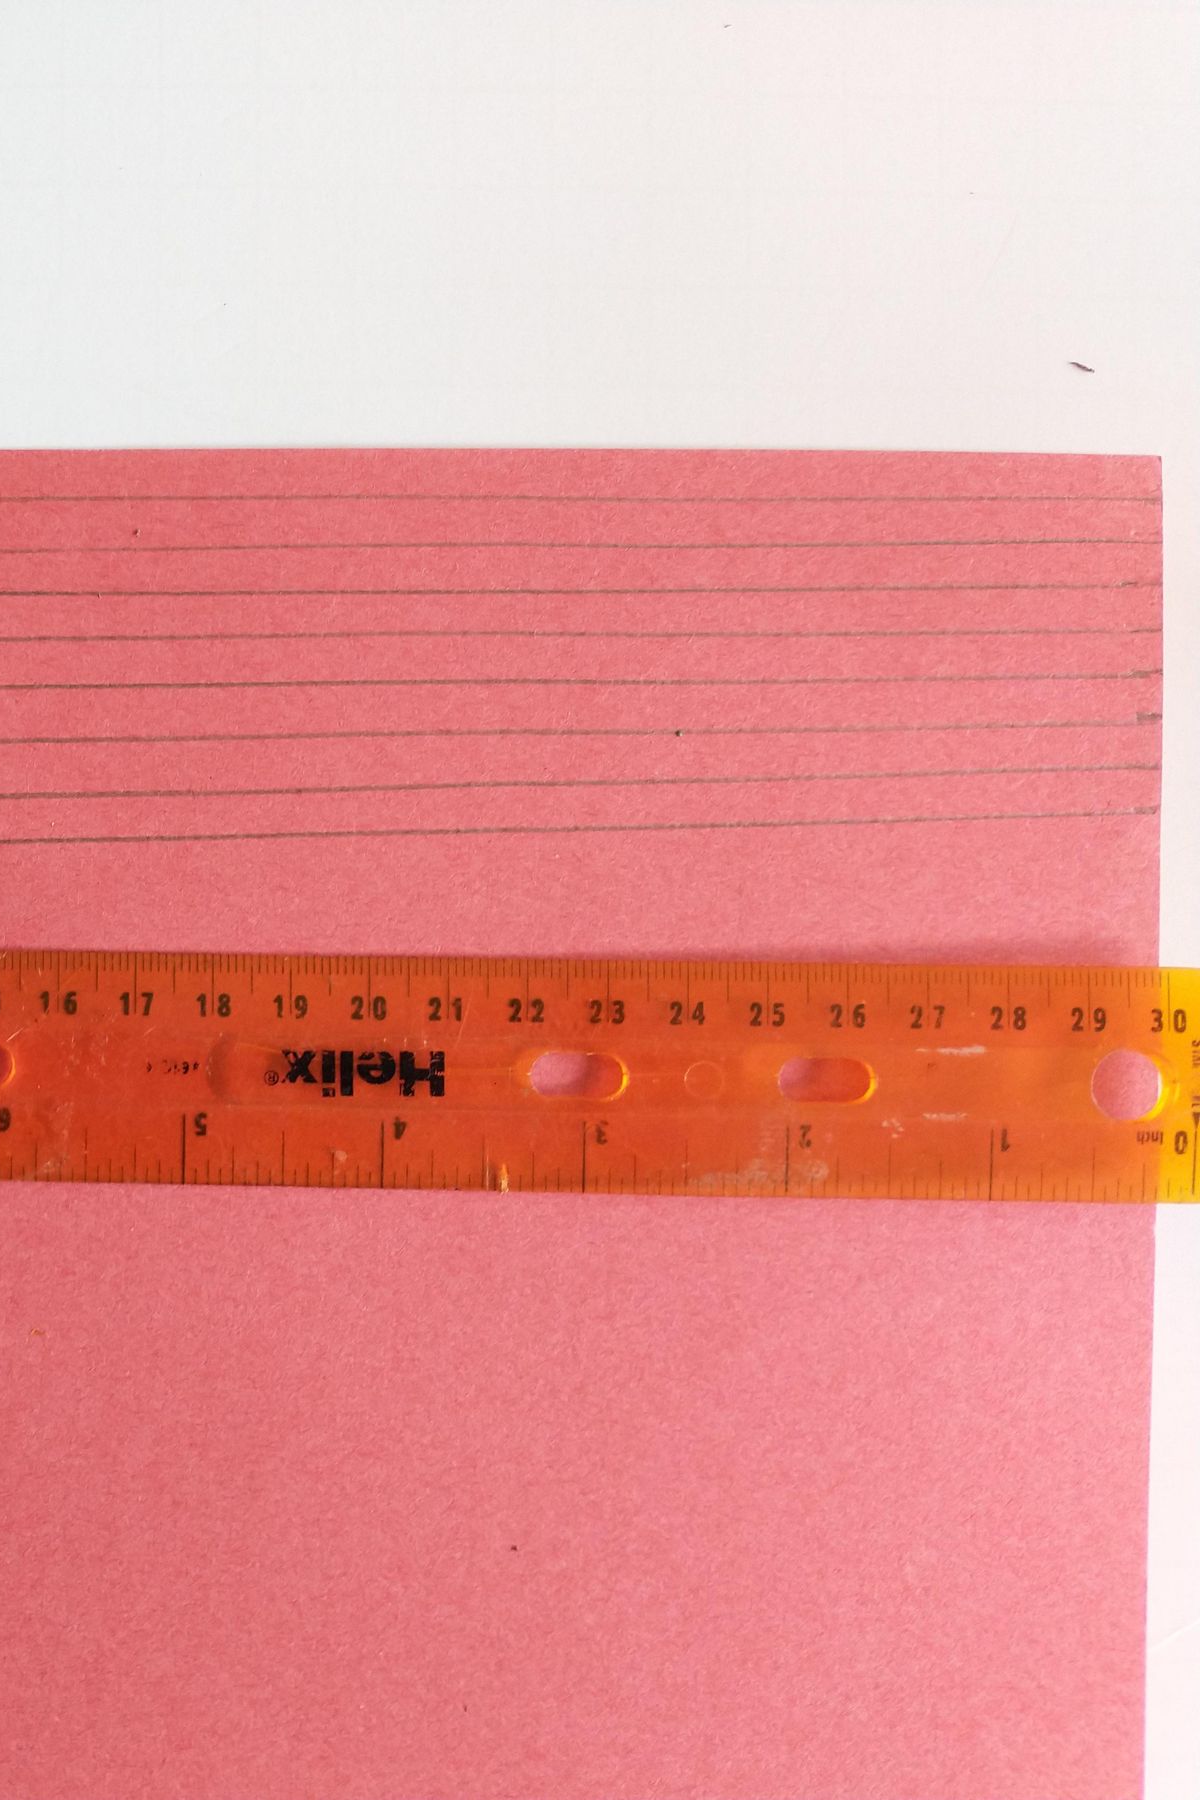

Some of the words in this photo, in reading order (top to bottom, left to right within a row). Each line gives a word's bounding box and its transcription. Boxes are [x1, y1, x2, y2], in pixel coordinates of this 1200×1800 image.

[40, 991, 78, 1015] 16
[120, 992, 154, 1016] 17
[197, 993, 232, 1017] 18
[274, 995, 308, 1018] 19
[351, 996, 387, 1020] 20
[429, 997, 462, 1021] 21
[509, 999, 545, 1022] 22
[590, 1000, 625, 1024] 23
[670, 1002, 705, 1025] 24
[750, 1003, 785, 1027] 25
[830, 1004, 866, 1028] 26
[910, 1005, 945, 1029] 27
[991, 1006, 1027, 1031] 28
[1072, 1007, 1107, 1031] 29
[1151, 1008, 1187, 1033] 30
[194, 1112, 207, 1136] 5
[393, 1116, 407, 1140] 4
[594, 1120, 609, 1145] 3
[799, 1124, 812, 1149] 2
[1000, 1128, 1011, 1152] 1
[1174, 1131, 1188, 1155] 0
